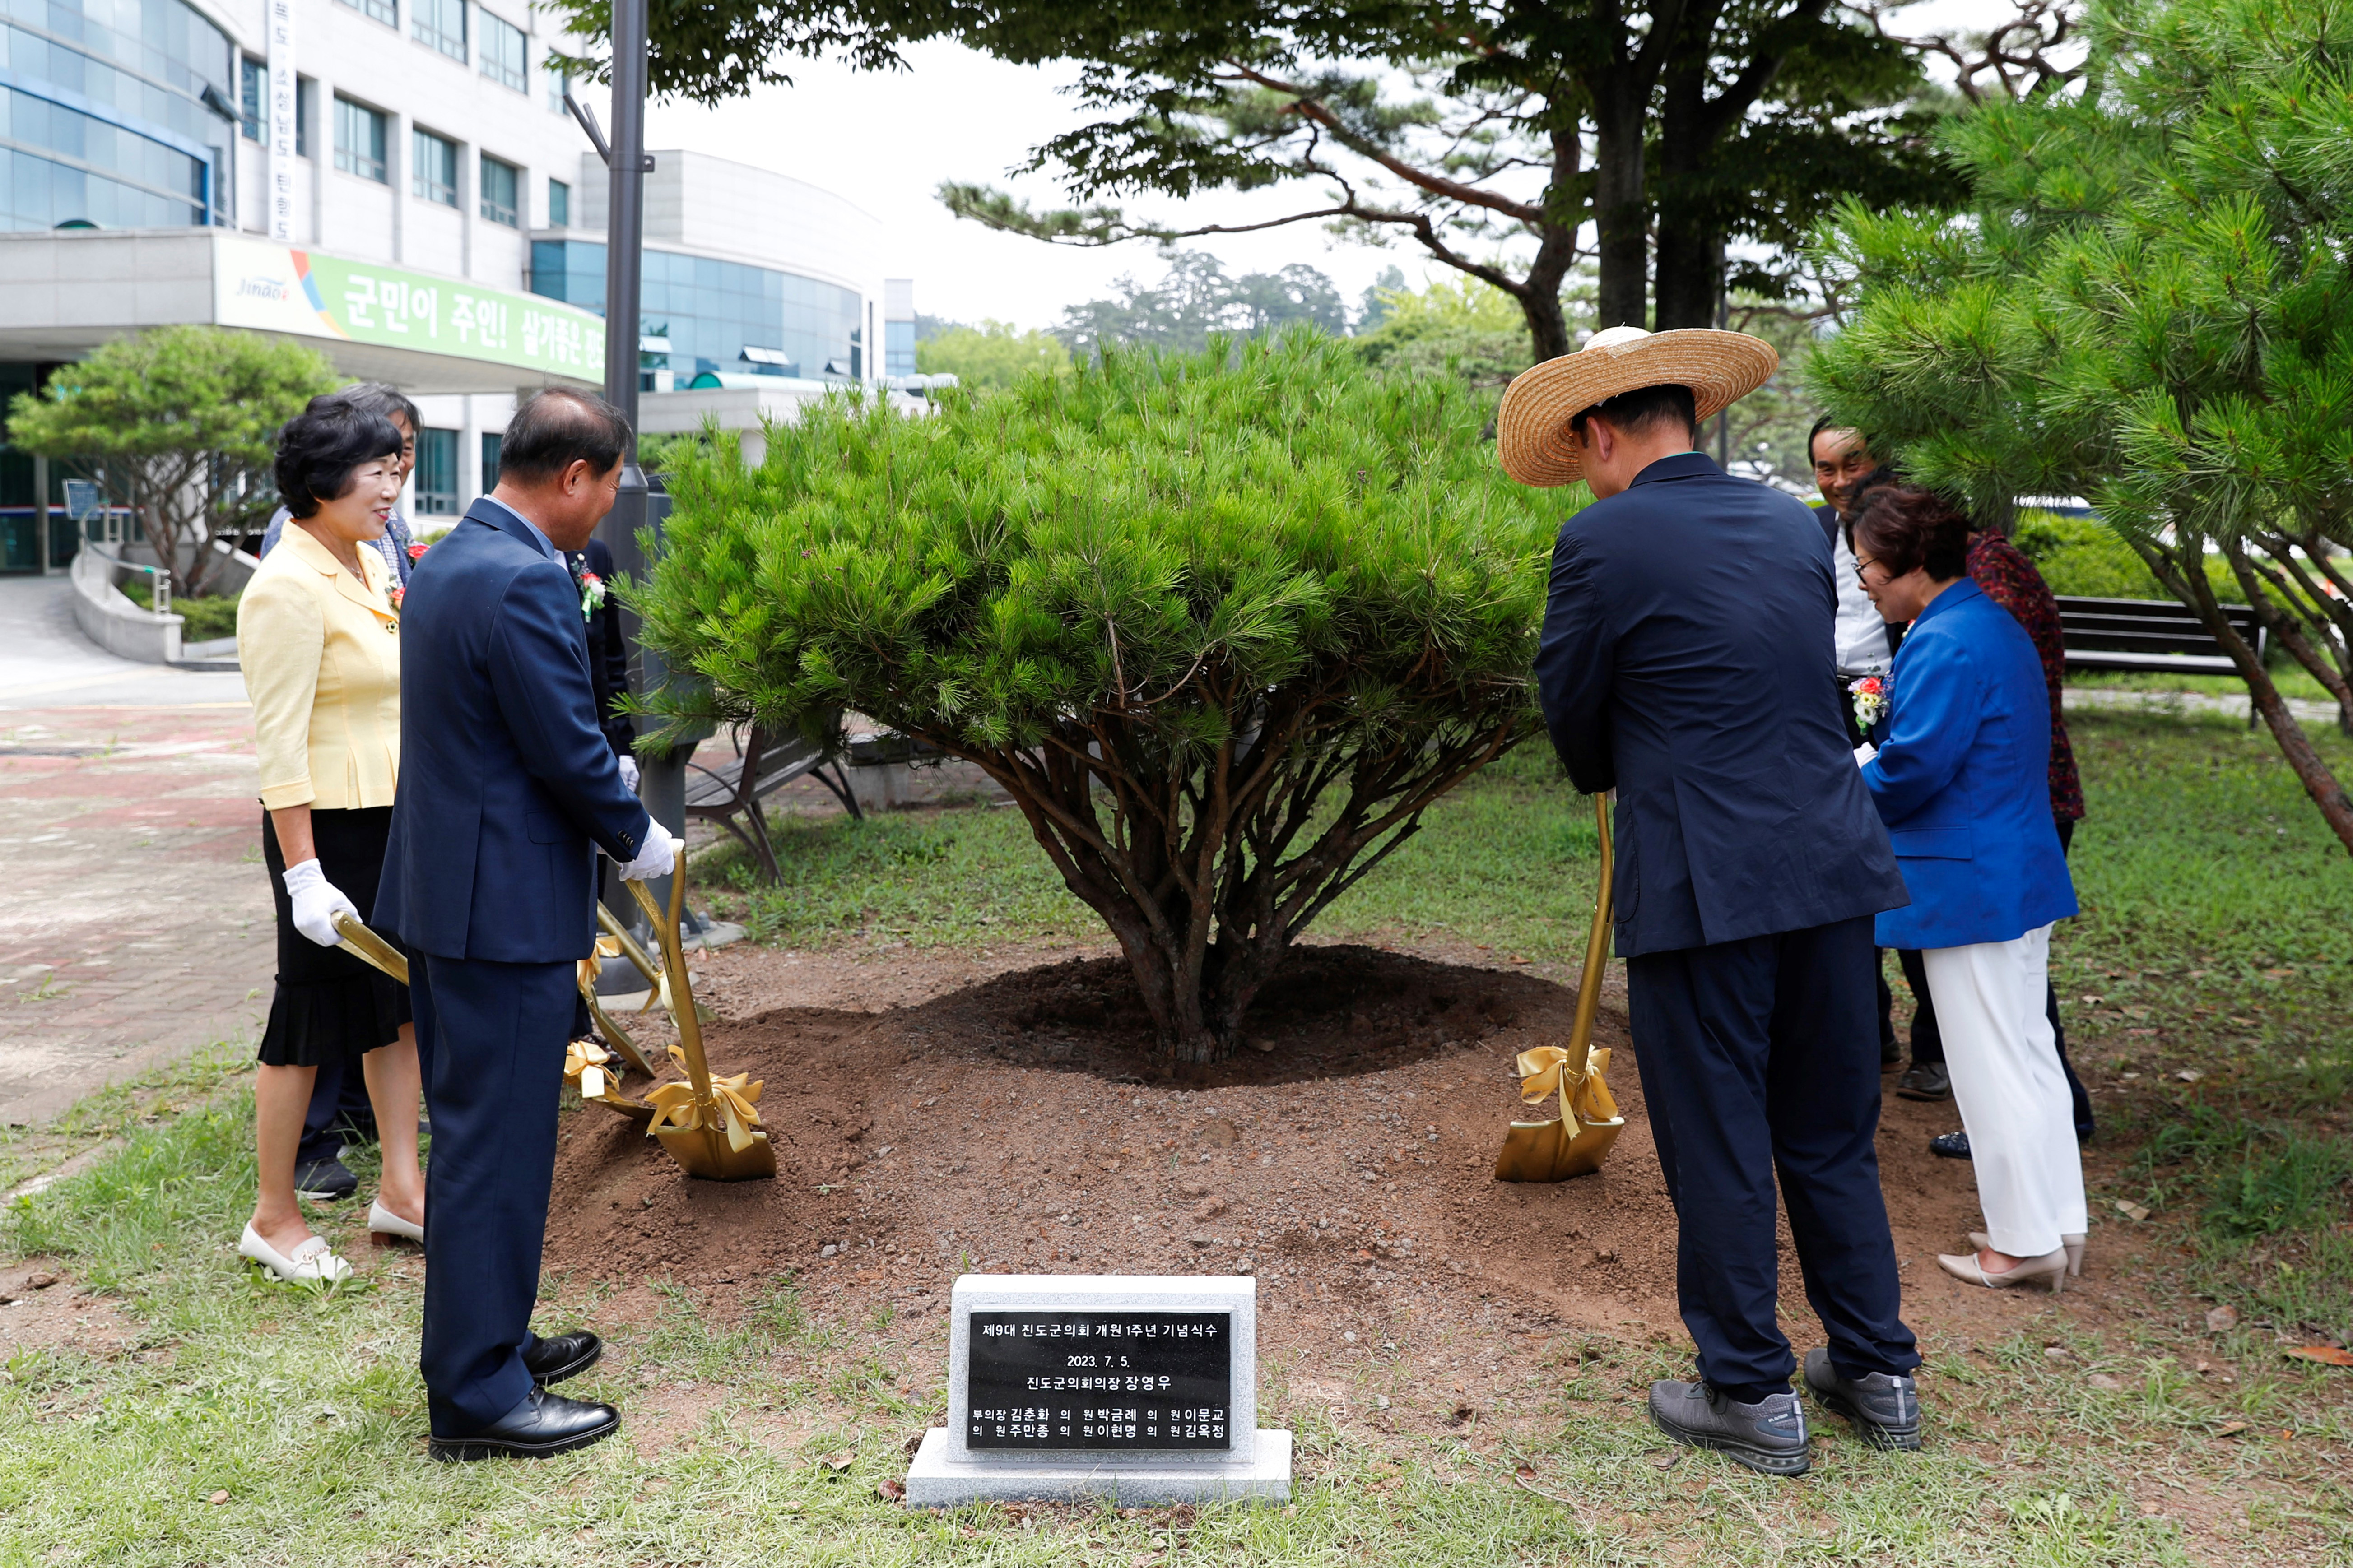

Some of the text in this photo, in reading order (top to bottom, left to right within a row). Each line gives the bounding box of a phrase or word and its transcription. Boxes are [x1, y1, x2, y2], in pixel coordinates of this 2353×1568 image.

[235, 277, 281, 300] Jindo
[344, 273, 437, 338] 군민이
[451, 294, 507, 349] 주인!
[521, 310, 581, 366] 살기좋은
[982, 1324, 1217, 1337] 제9대 진도군의회 개원 1주년 기념식수
[1067, 1355, 1130, 1368] 2023. 7. 5.
[1027, 1376, 1171, 1391] 진도군의회의장 장영우
[972, 1409, 1006, 1421] 부의장
[1011, 1407, 1050, 1421] 김춘화
[1097, 1408, 1136, 1422] 박금례
[1185, 1408, 1224, 1422] 이문교
[1009, 1424, 1049, 1438] 주만종
[1097, 1424, 1136, 1438] 이현명
[1185, 1424, 1224, 1438] 김옥정
